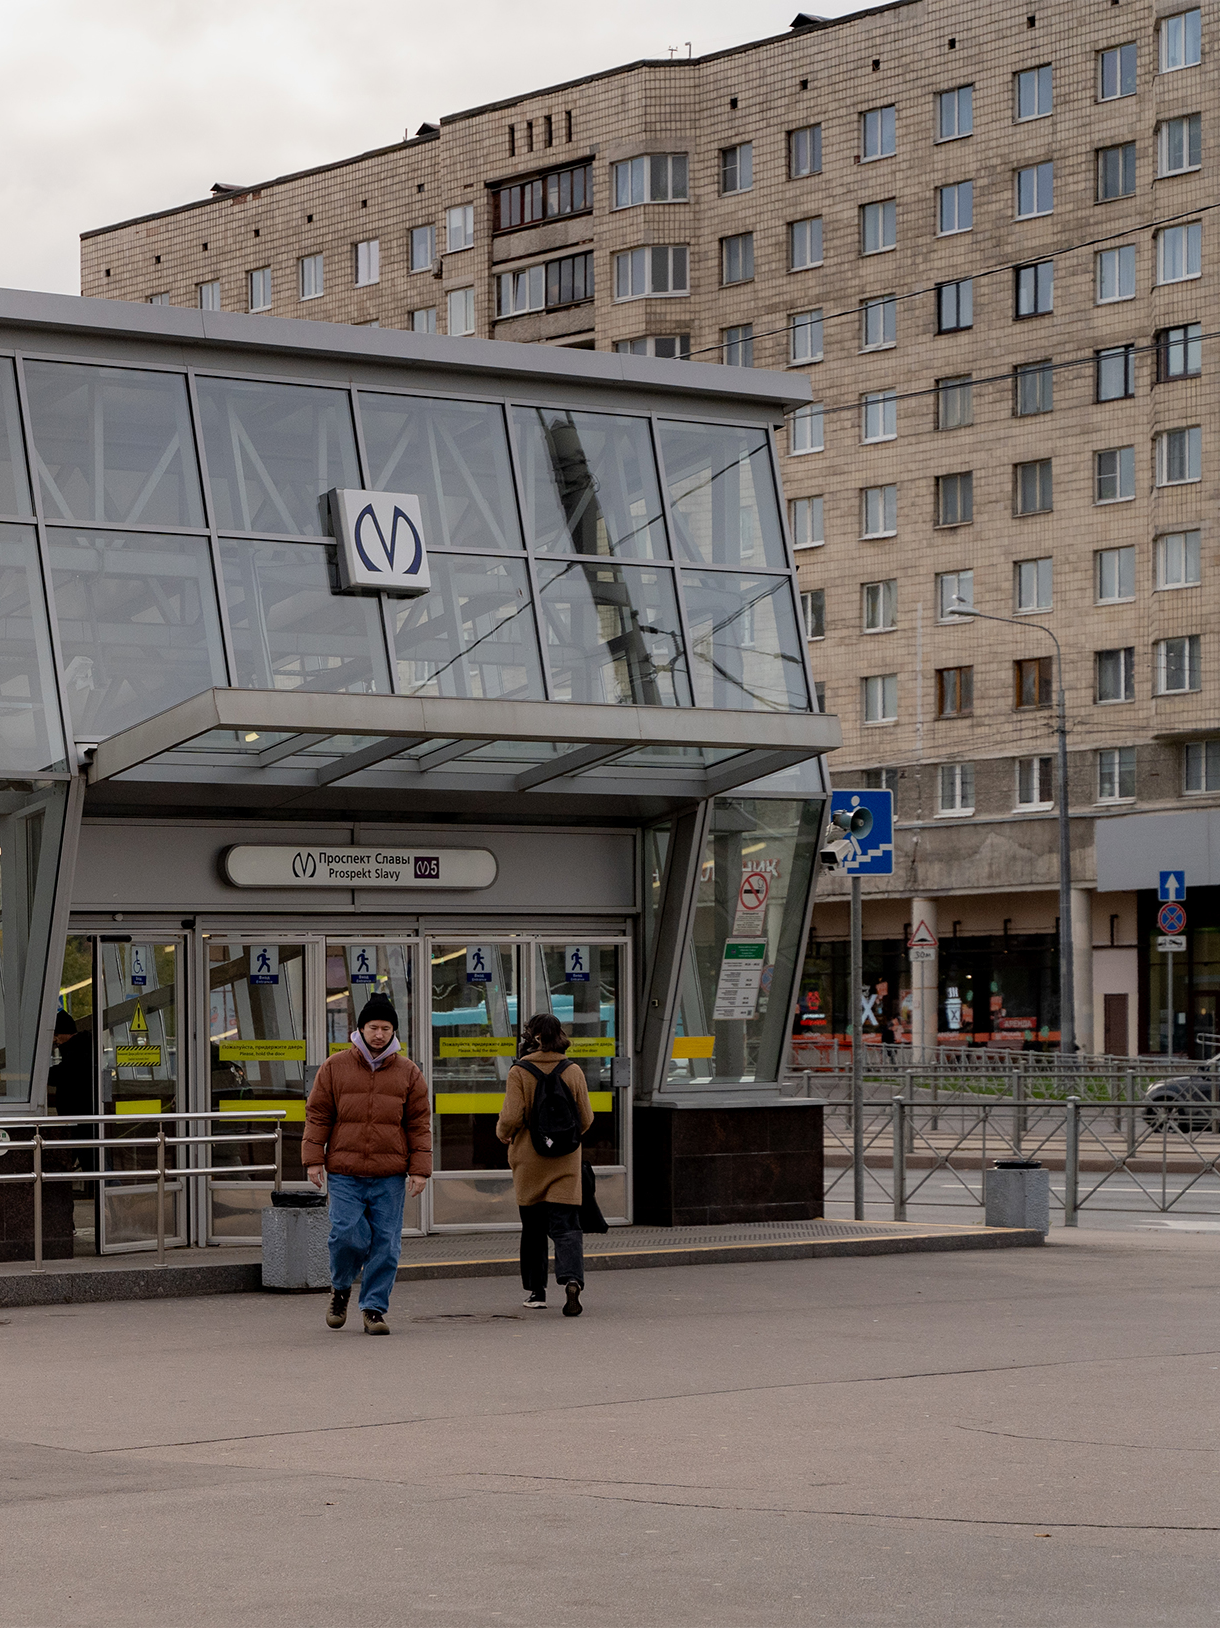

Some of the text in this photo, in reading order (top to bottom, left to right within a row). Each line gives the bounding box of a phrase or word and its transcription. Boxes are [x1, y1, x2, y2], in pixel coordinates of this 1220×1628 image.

[319, 852, 410, 866] Проспект Славы
[329, 867, 401, 882] Prospekt Slavy
[1004, 1019, 1033, 1028] АРЕНДА
